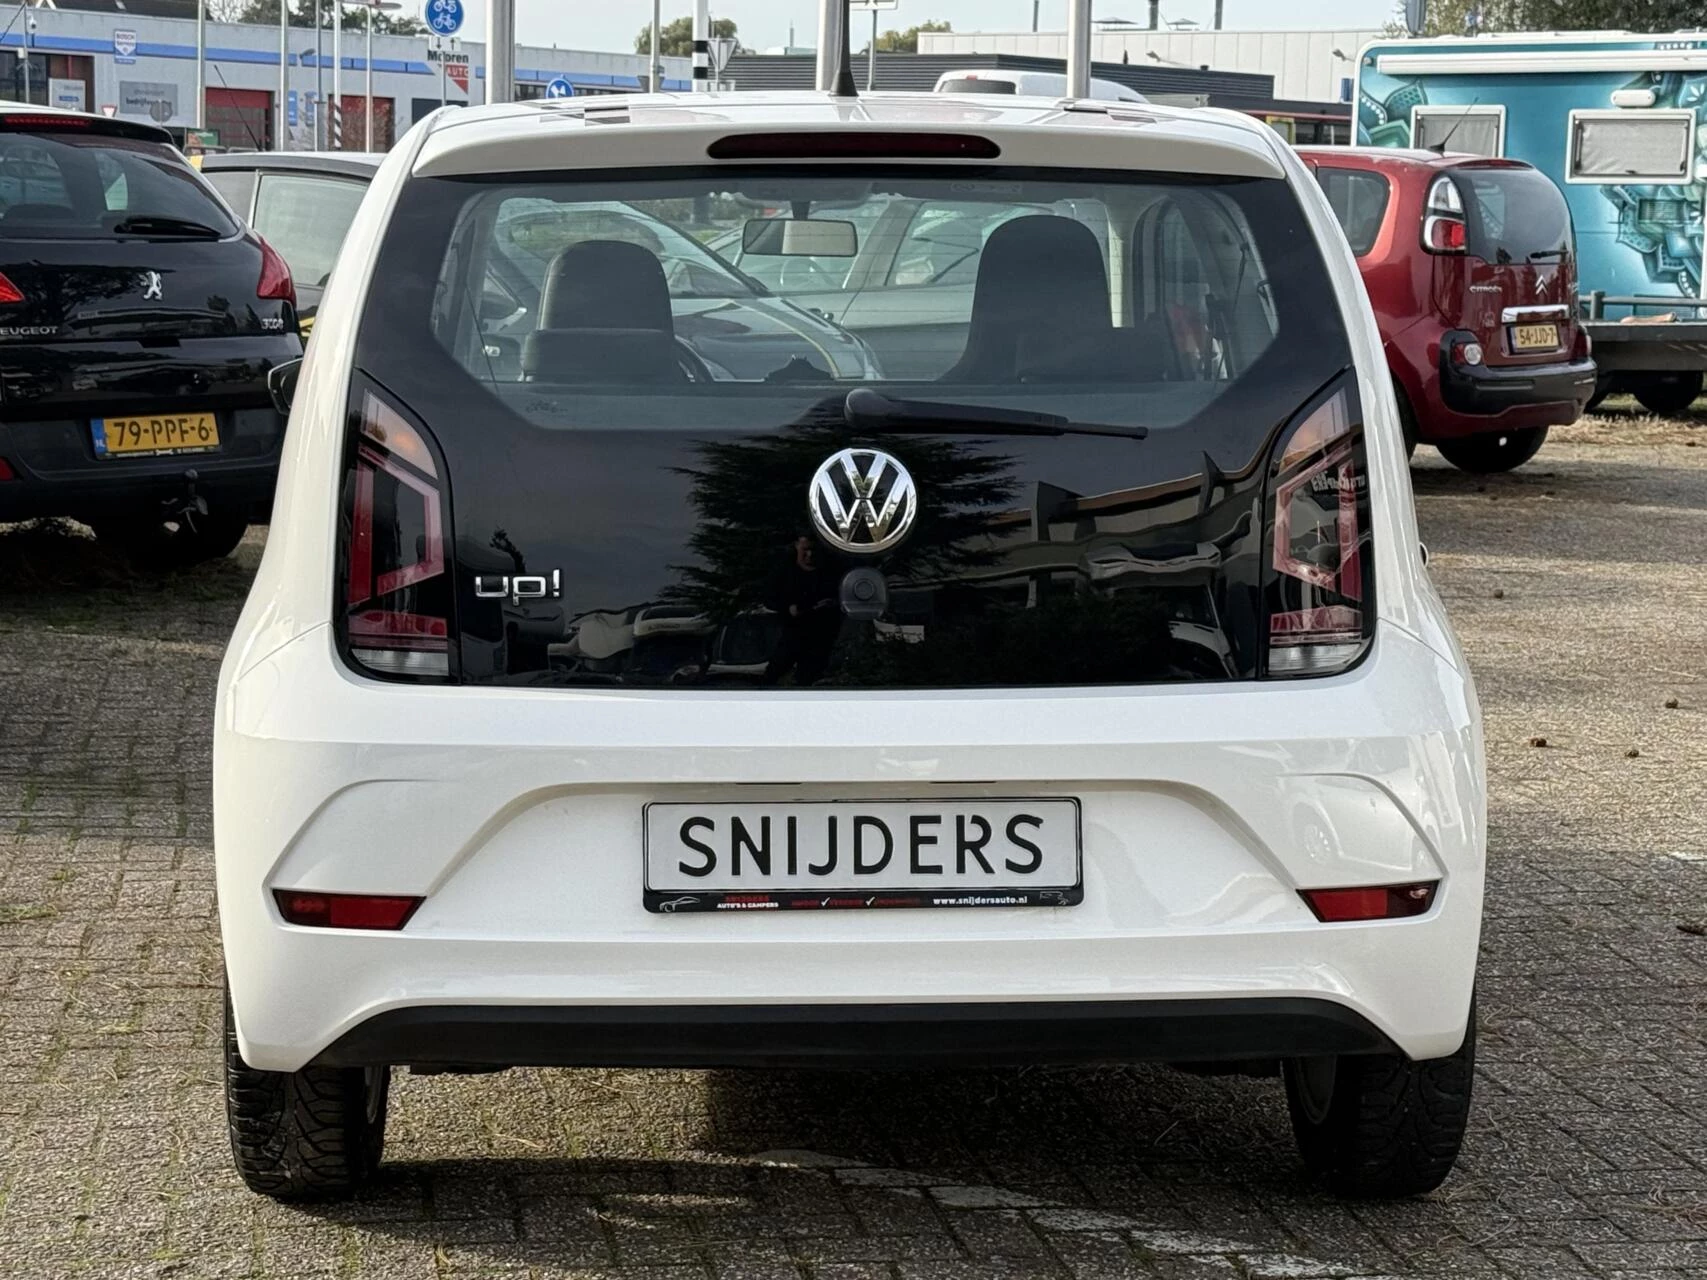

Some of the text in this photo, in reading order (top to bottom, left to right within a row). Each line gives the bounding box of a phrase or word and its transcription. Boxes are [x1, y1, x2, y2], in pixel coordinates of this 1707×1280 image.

[113, 416, 210, 447] 79-PPF-6
[475, 569, 561, 606] up!
[678, 813, 1044, 877] SNIJDERS
[933, 896, 1028, 906] www.snijdersauto.nl
